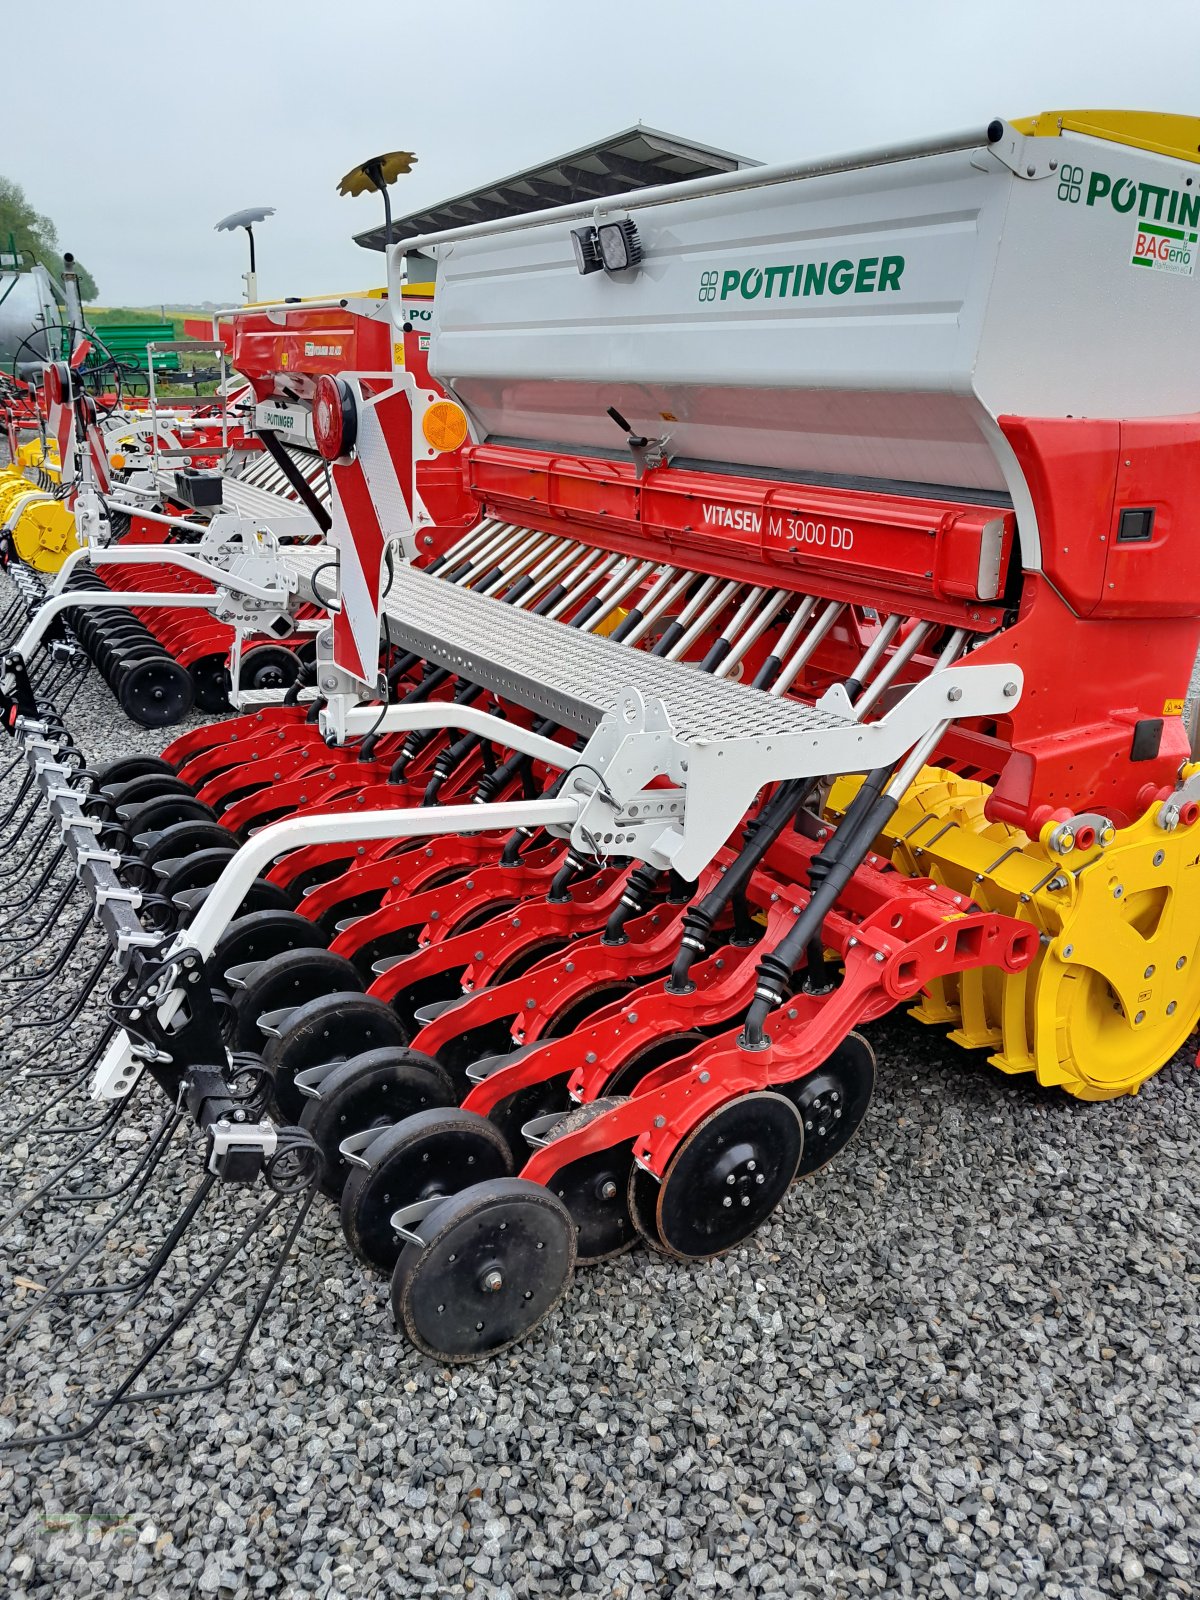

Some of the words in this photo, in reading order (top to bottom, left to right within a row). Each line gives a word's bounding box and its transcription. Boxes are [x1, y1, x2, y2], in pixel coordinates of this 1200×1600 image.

[1135, 233, 1190, 264] BAGeno
[769, 516, 782, 538] M
[786, 518, 826, 545] 3000
[830, 526, 854, 550] DD
